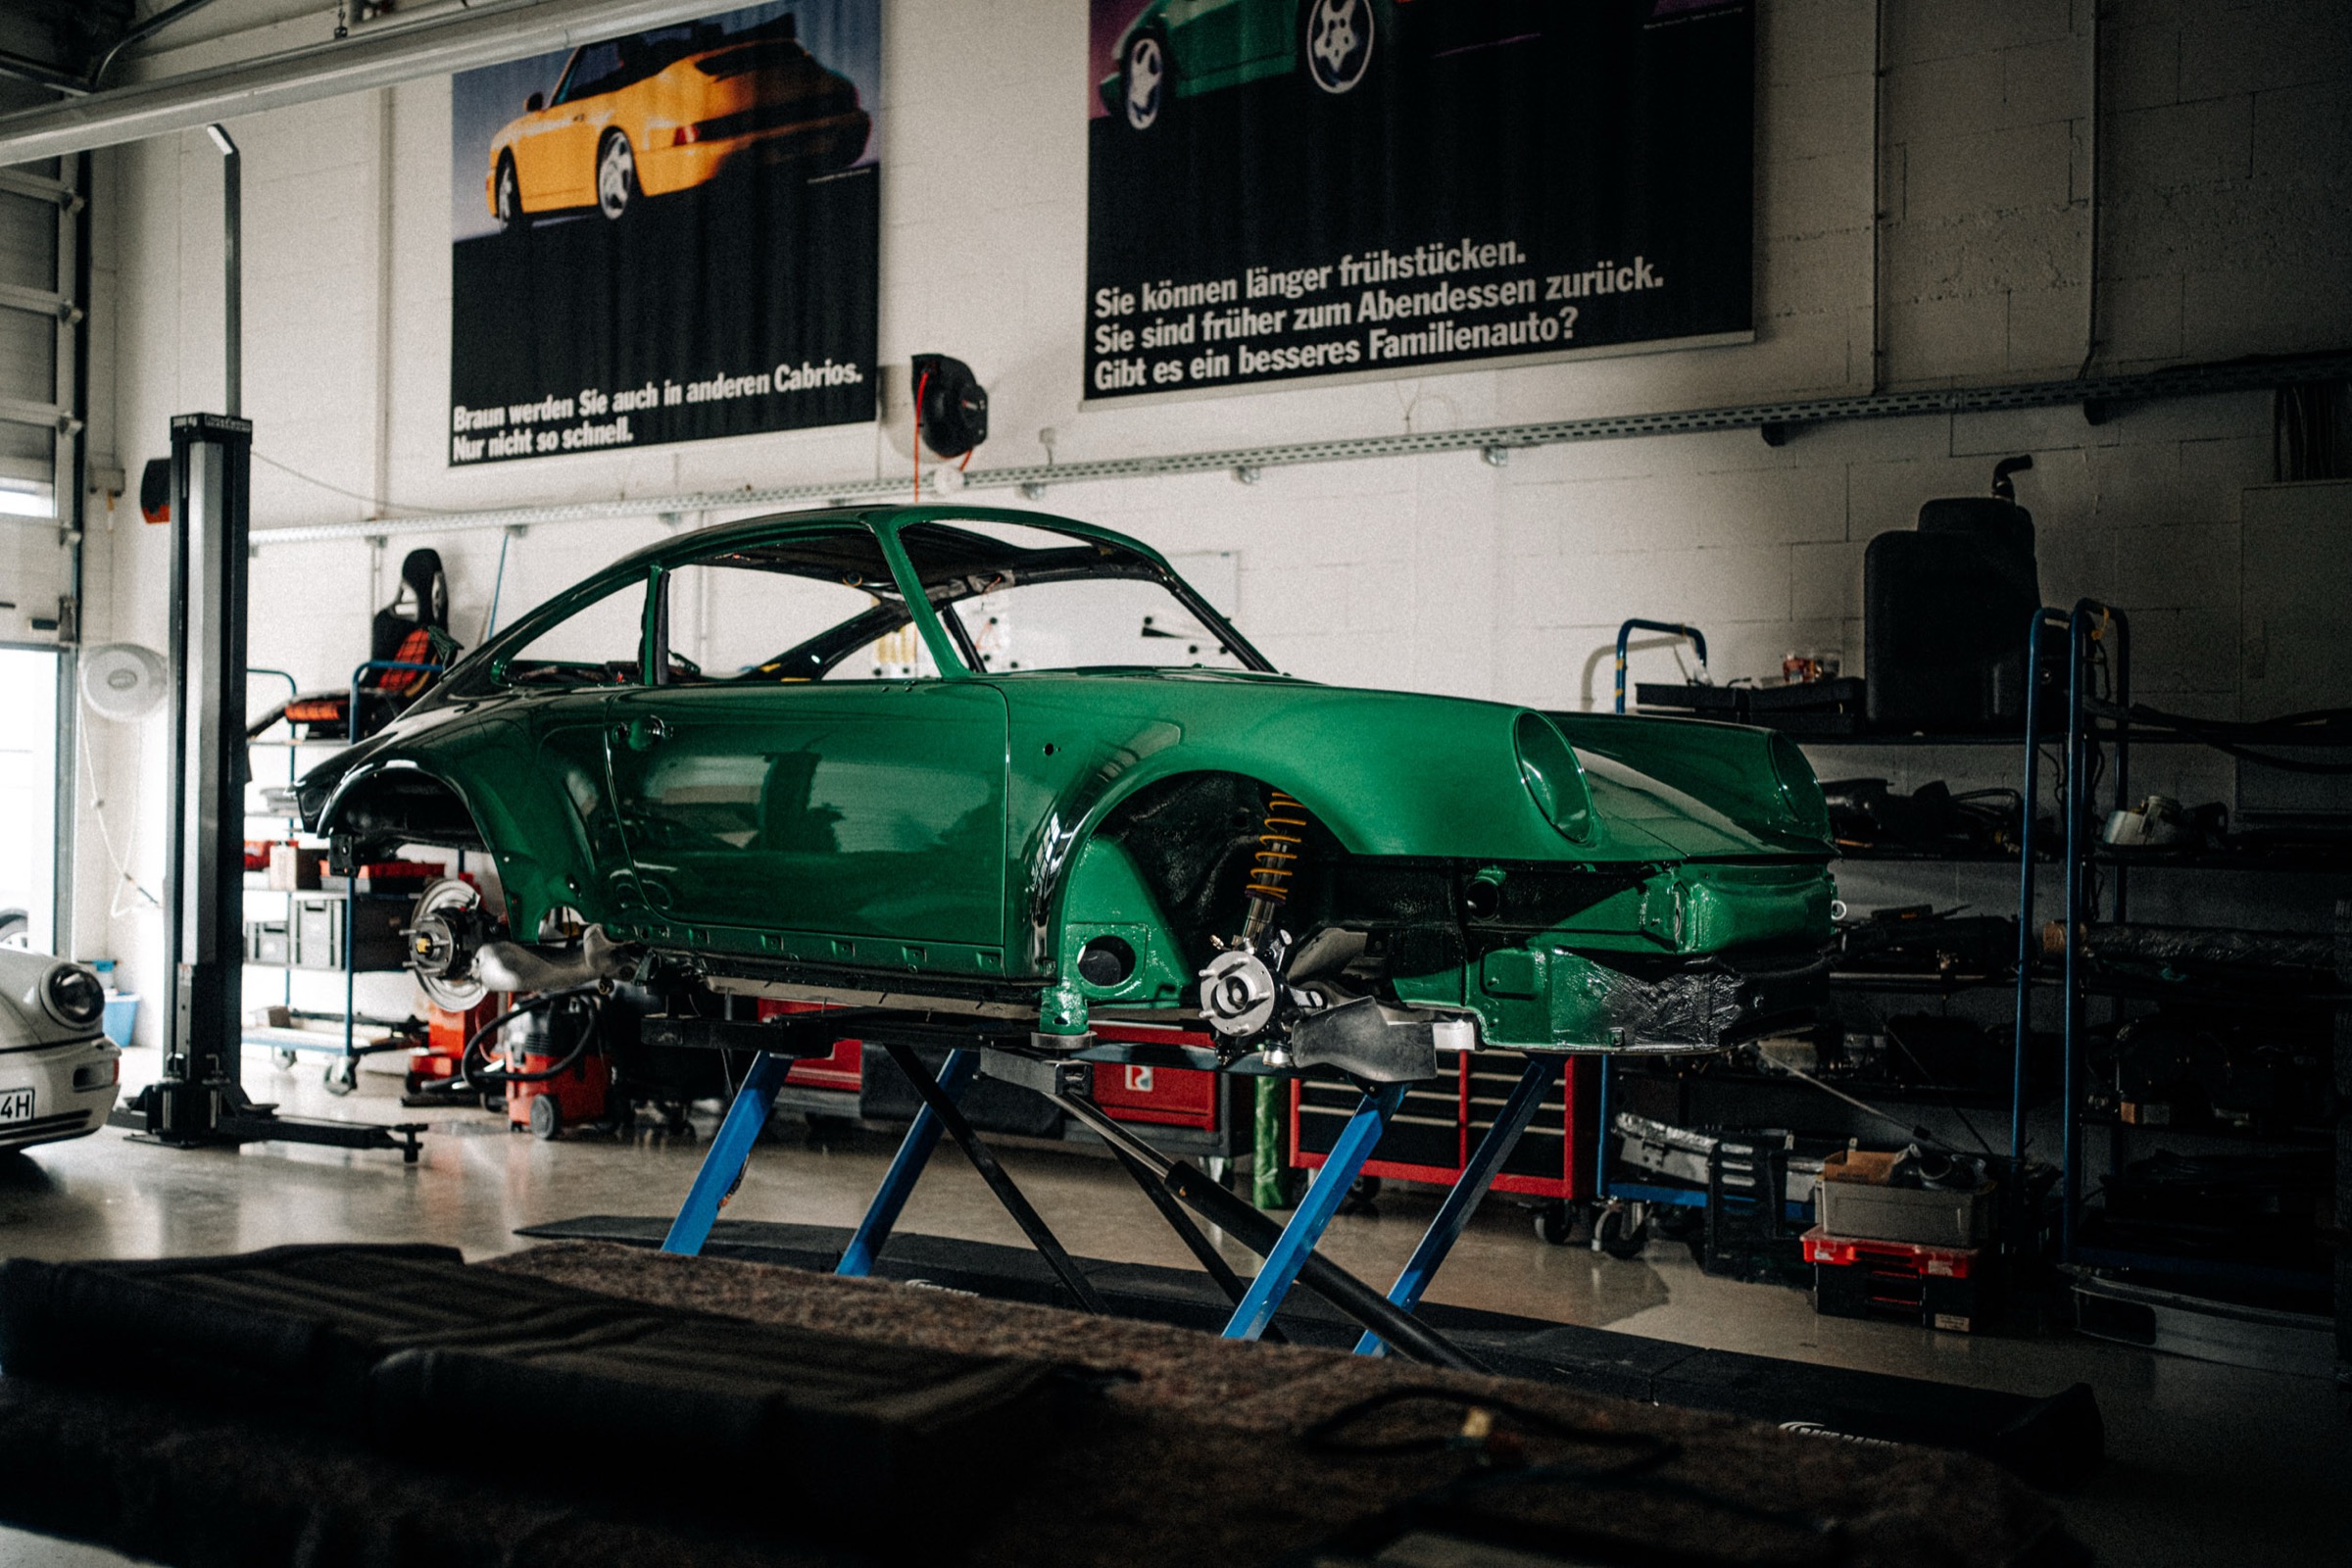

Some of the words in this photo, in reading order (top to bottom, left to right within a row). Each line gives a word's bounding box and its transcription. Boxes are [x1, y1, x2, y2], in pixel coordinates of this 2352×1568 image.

[1095, 286, 1135, 318] Sie
[1142, 279, 1238, 313] können
[1246, 266, 1333, 299] länger
[1338, 238, 1527, 286] frühstücken.
[1095, 322, 1135, 355] Sie
[1141, 313, 1196, 349] sind
[1201, 307, 1288, 341] früher
[1293, 302, 1351, 331] zum
[1356, 280, 1537, 323] Abendessen
[1544, 256, 1664, 301] zurück.
[1094, 357, 1147, 391] Gibt
[1152, 360, 1184, 384] es
[1190, 348, 1230, 380] ein
[1239, 339, 1361, 375] besseres
[1368, 306, 1579, 361] Familienauto?
[453, 405, 506, 432] Braun
[508, 394, 574, 425] werden
[578, 388, 609, 416] Sie
[612, 381, 659, 413] auch
[663, 379, 683, 407] in
[686, 371, 770, 403] anderen
[773, 358, 863, 393] Cabrios.
[453, 435, 486, 463] Nur
[488, 427, 533, 458] nicht
[536, 430, 560, 453] so
[562, 416, 634, 450] schnell.
